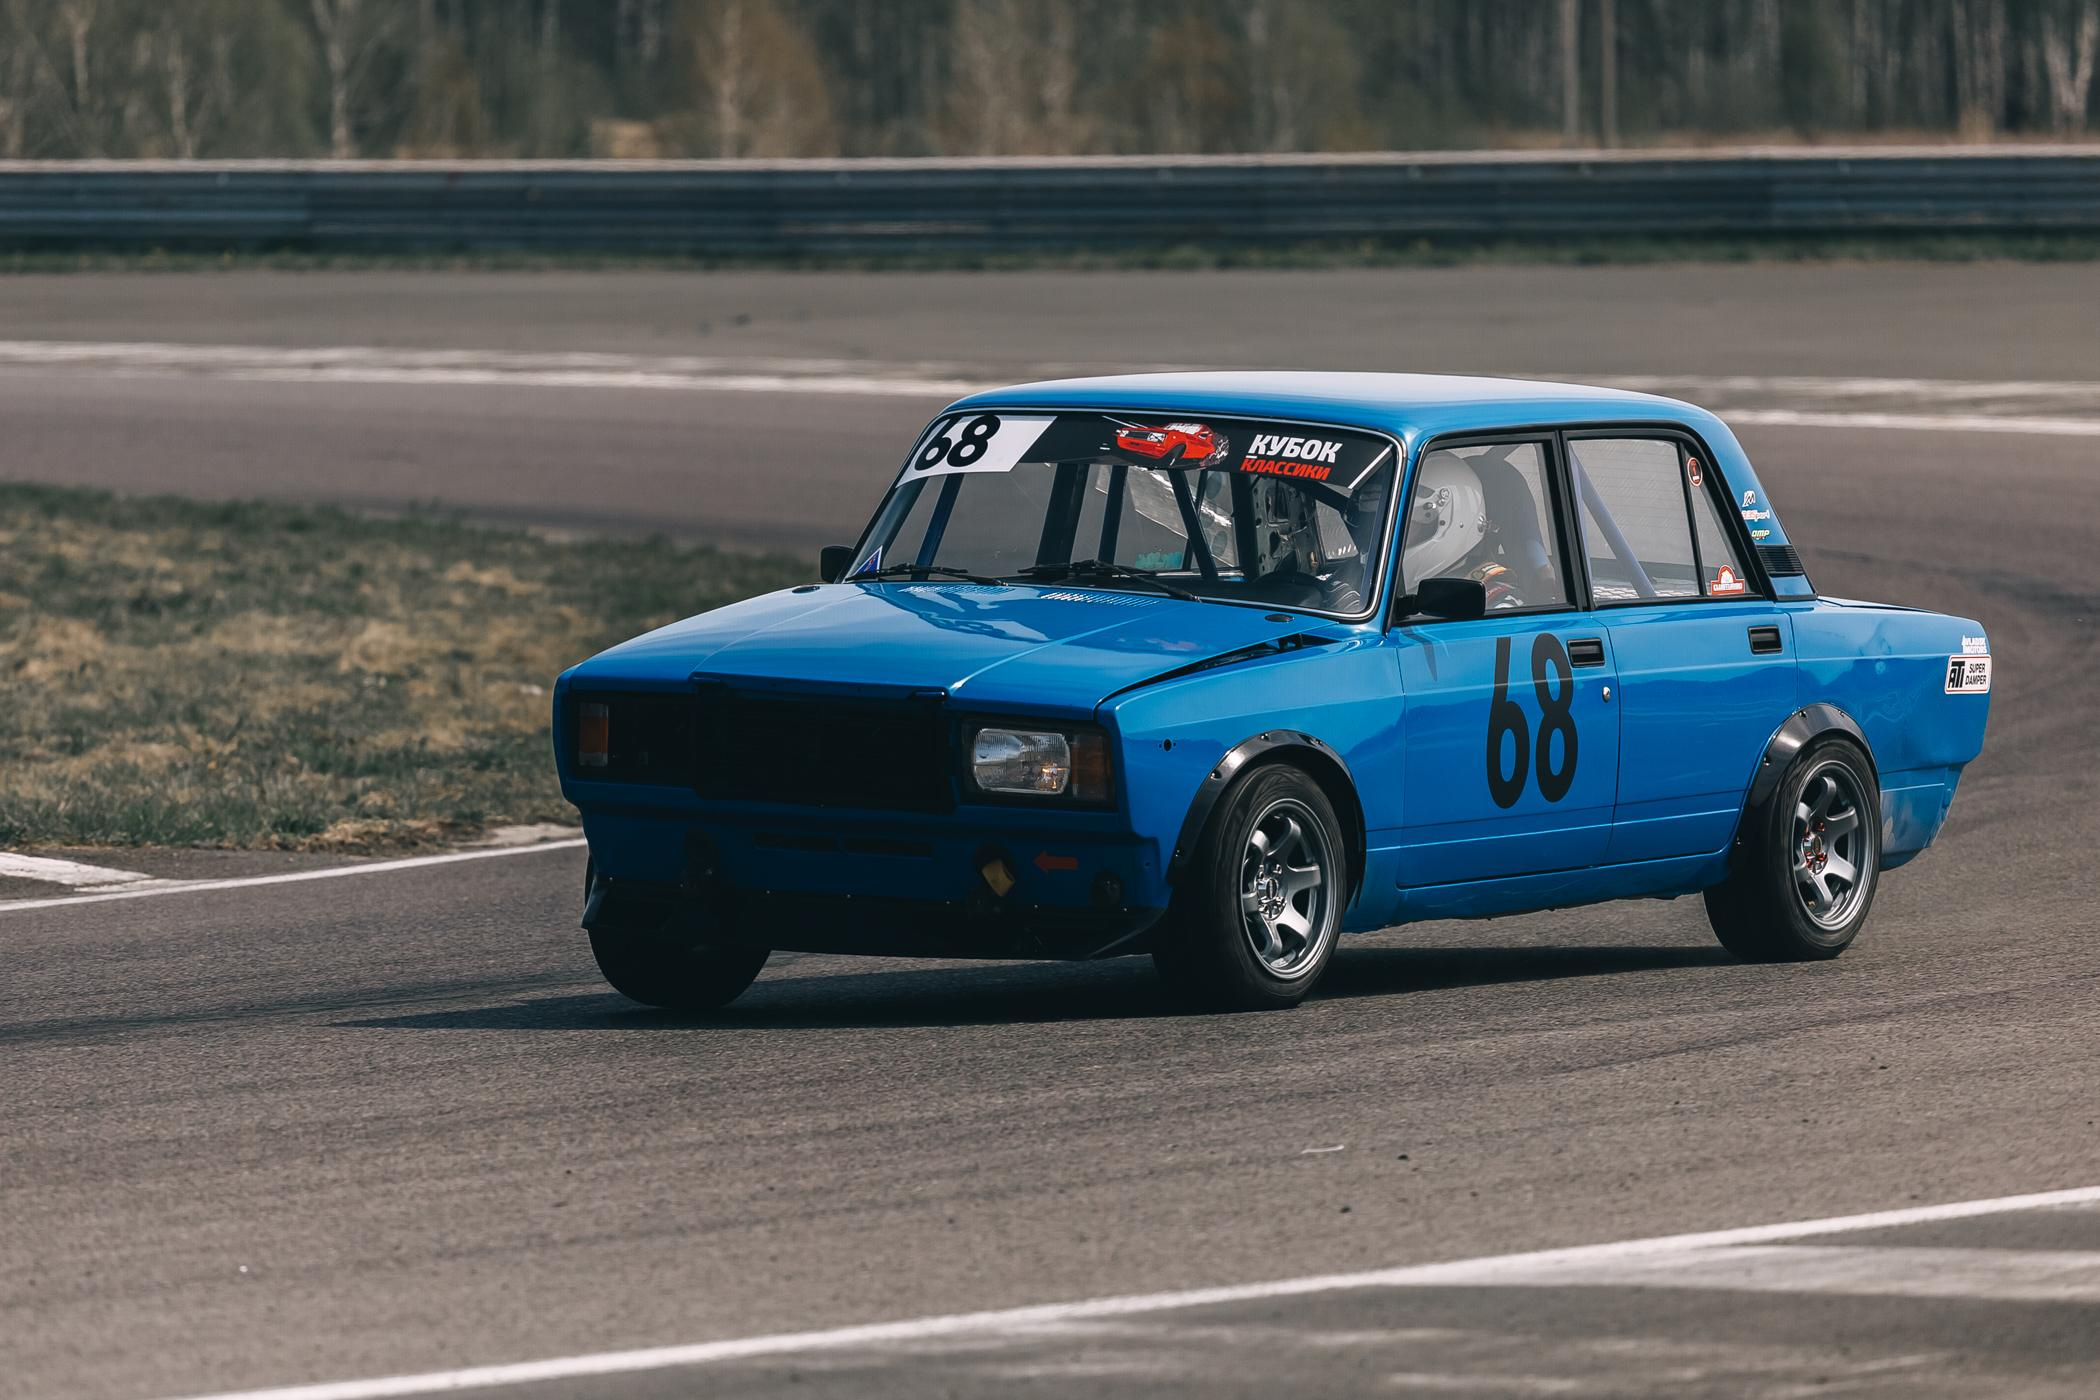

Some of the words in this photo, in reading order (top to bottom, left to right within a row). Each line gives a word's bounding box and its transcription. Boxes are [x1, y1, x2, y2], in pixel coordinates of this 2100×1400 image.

[914, 414, 1001, 471] 68
[1247, 434, 1343, 463] КУБОК
[1240, 457, 1332, 481] КЛАССИКИ
[1965, 675, 1986, 685] DAMPER
[1969, 663, 1986, 673] SUPER
[1486, 632, 1579, 809] 68
